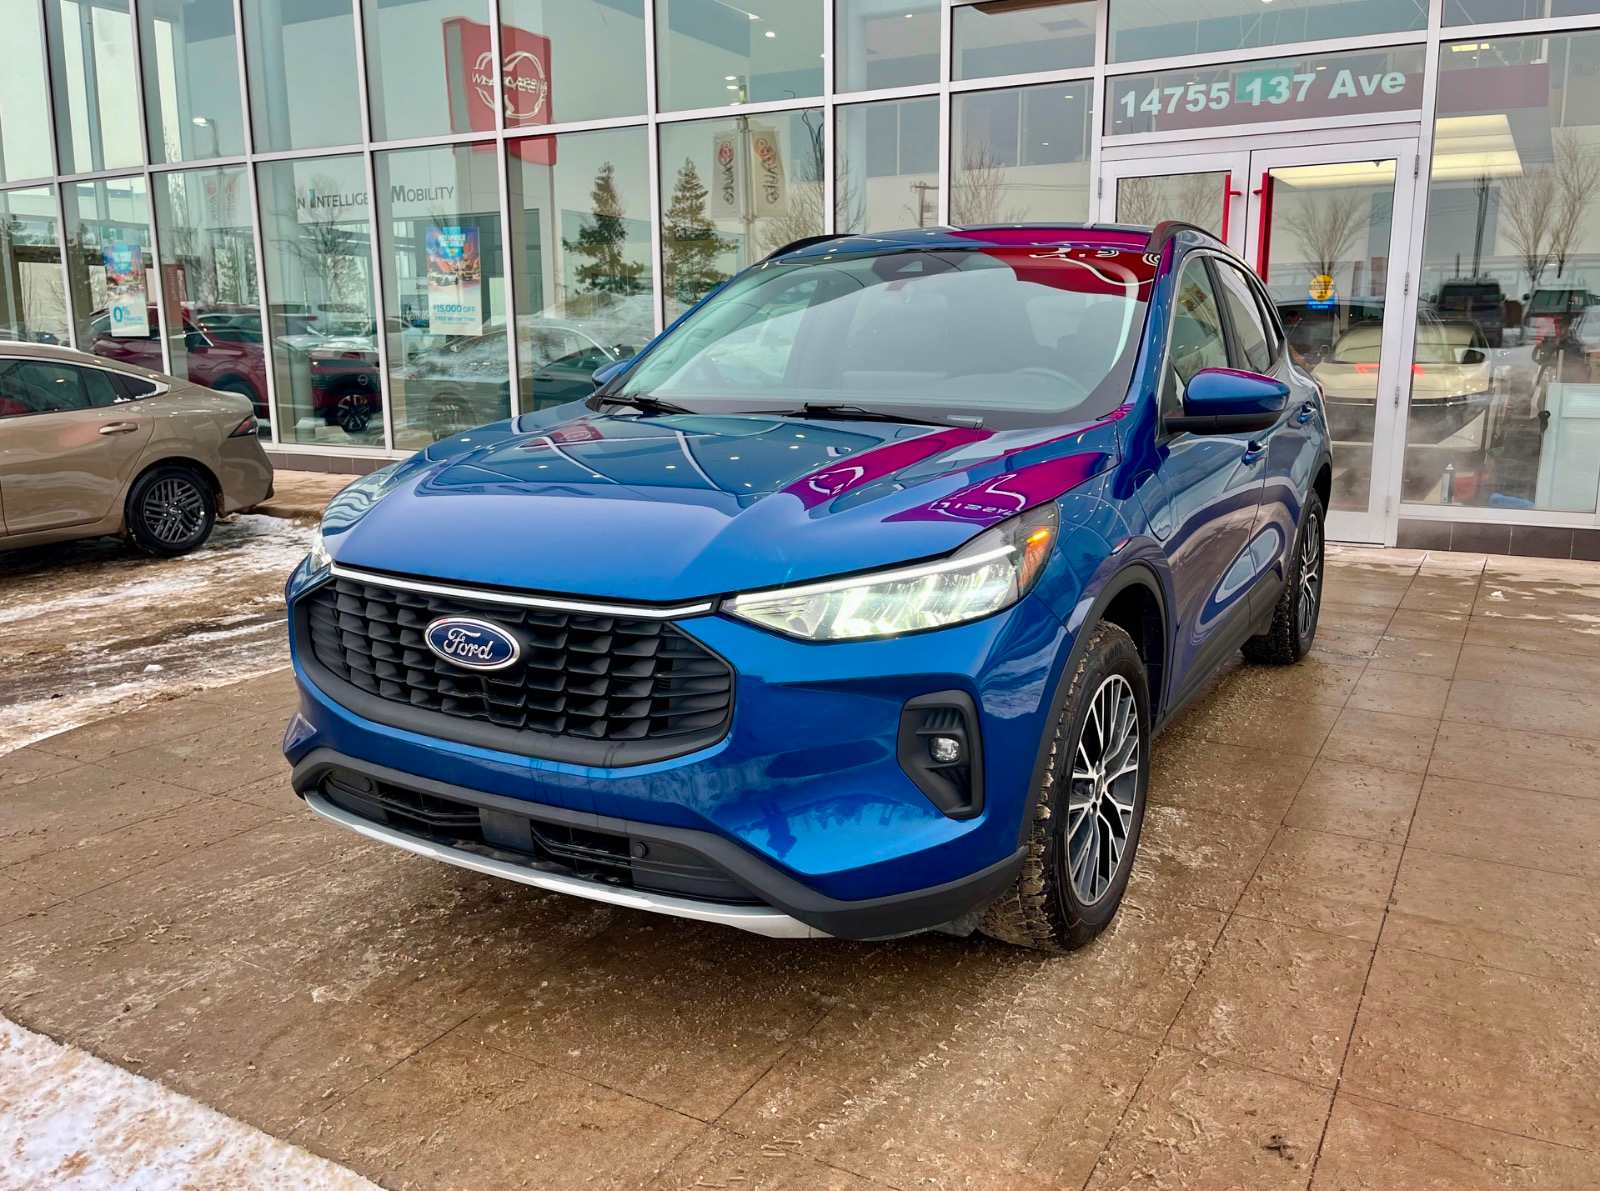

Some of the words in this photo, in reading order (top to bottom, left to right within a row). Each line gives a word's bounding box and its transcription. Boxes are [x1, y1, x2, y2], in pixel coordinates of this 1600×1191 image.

[1120, 82, 1230, 118] 14755
[1245, 73, 1316, 107] 137
[1328, 69, 1406, 99] Ave
[309, 189, 368, 208] INTELLIGE
[392, 185, 454, 203] MOBILITY
[443, 627, 494, 659] Ford
